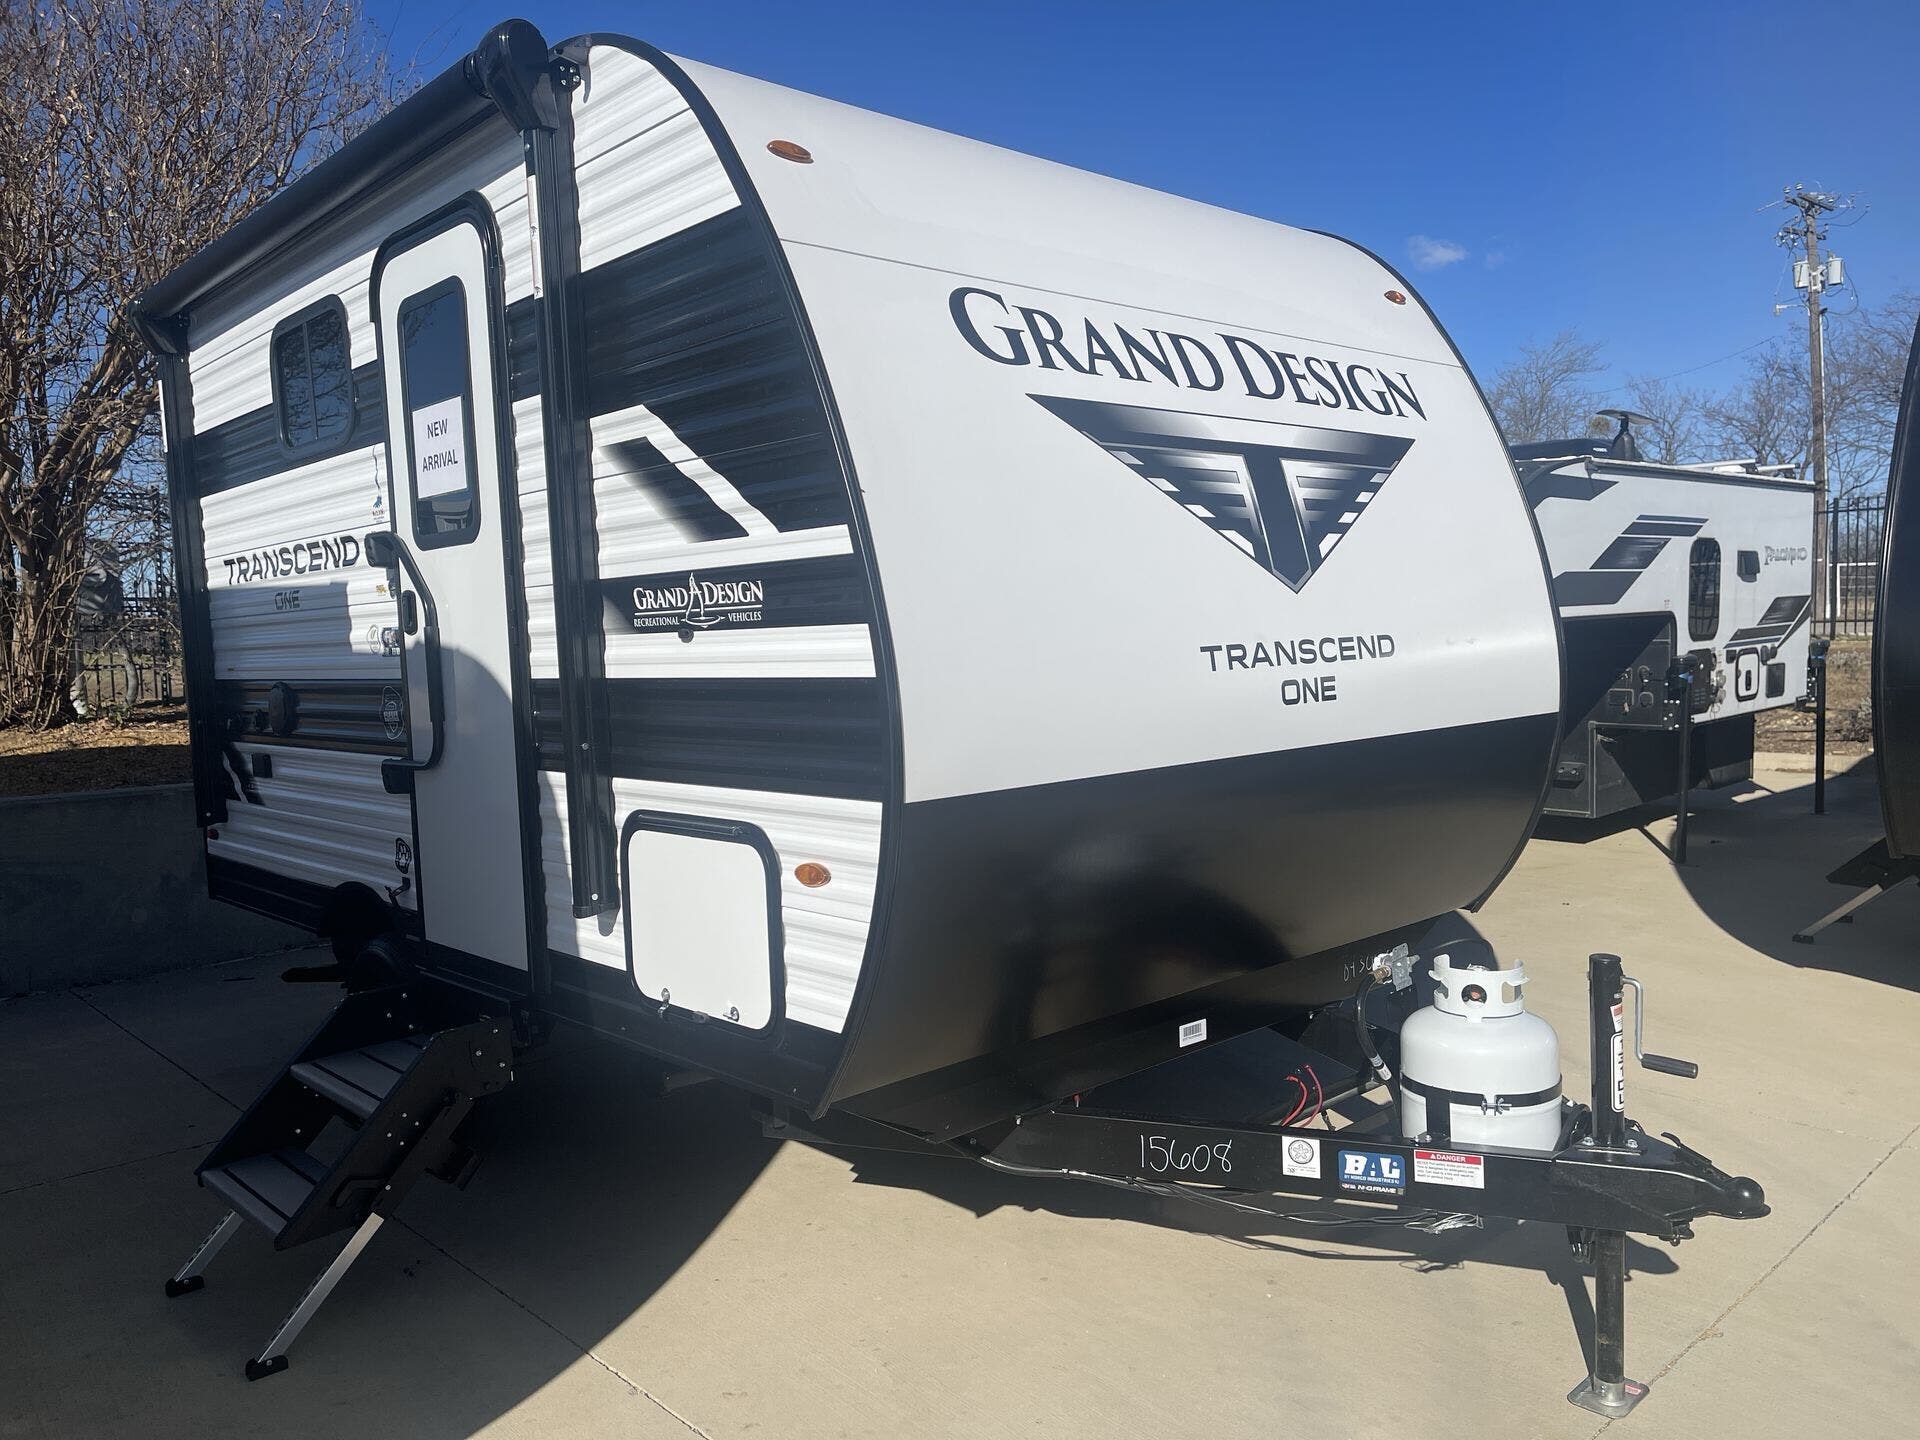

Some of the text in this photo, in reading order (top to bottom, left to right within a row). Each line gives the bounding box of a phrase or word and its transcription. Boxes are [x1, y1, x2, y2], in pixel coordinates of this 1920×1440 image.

[949, 286, 1427, 421] GRAND DESIGN
[427, 417, 448, 440] NEW
[422, 449, 459, 473] ARRIVAL
[223, 534, 361, 585] TRANSCEND
[274, 589, 301, 611] ONE
[633, 580, 764, 610] GRAND DESIGN
[633, 610, 762, 628] RECREATIONAL VEHICLES
[1200, 633, 1396, 672] TRANSCEND
[1281, 675, 1338, 706] ONE
[1140, 1134, 1232, 1172] 15608
[1436, 1153, 1467, 1163] DANGER
